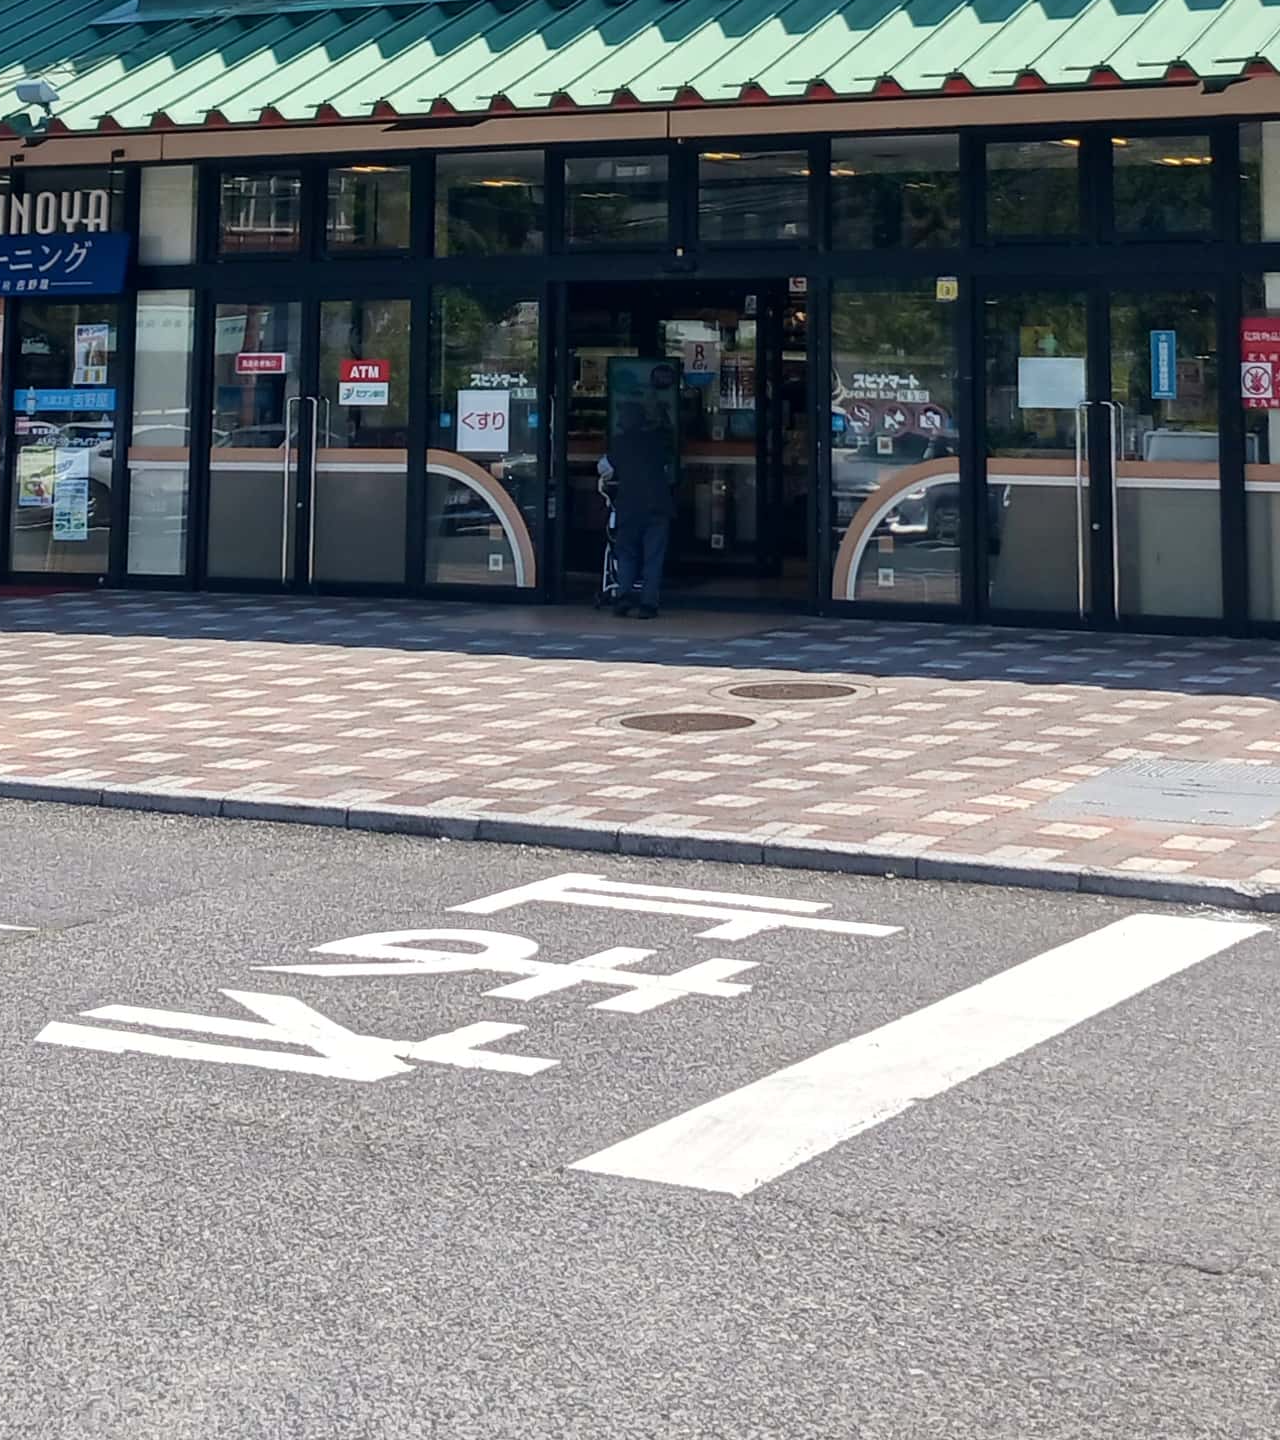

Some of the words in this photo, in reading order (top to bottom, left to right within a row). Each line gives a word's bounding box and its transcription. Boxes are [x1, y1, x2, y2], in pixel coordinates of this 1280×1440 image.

[349, 365, 380, 379] ATM
[470, 373, 529, 387] スピナマート
[853, 373, 920, 389] スピナマート
[461, 411, 505, 431] くすり
[32, 872, 905, 1082] 止まれ
